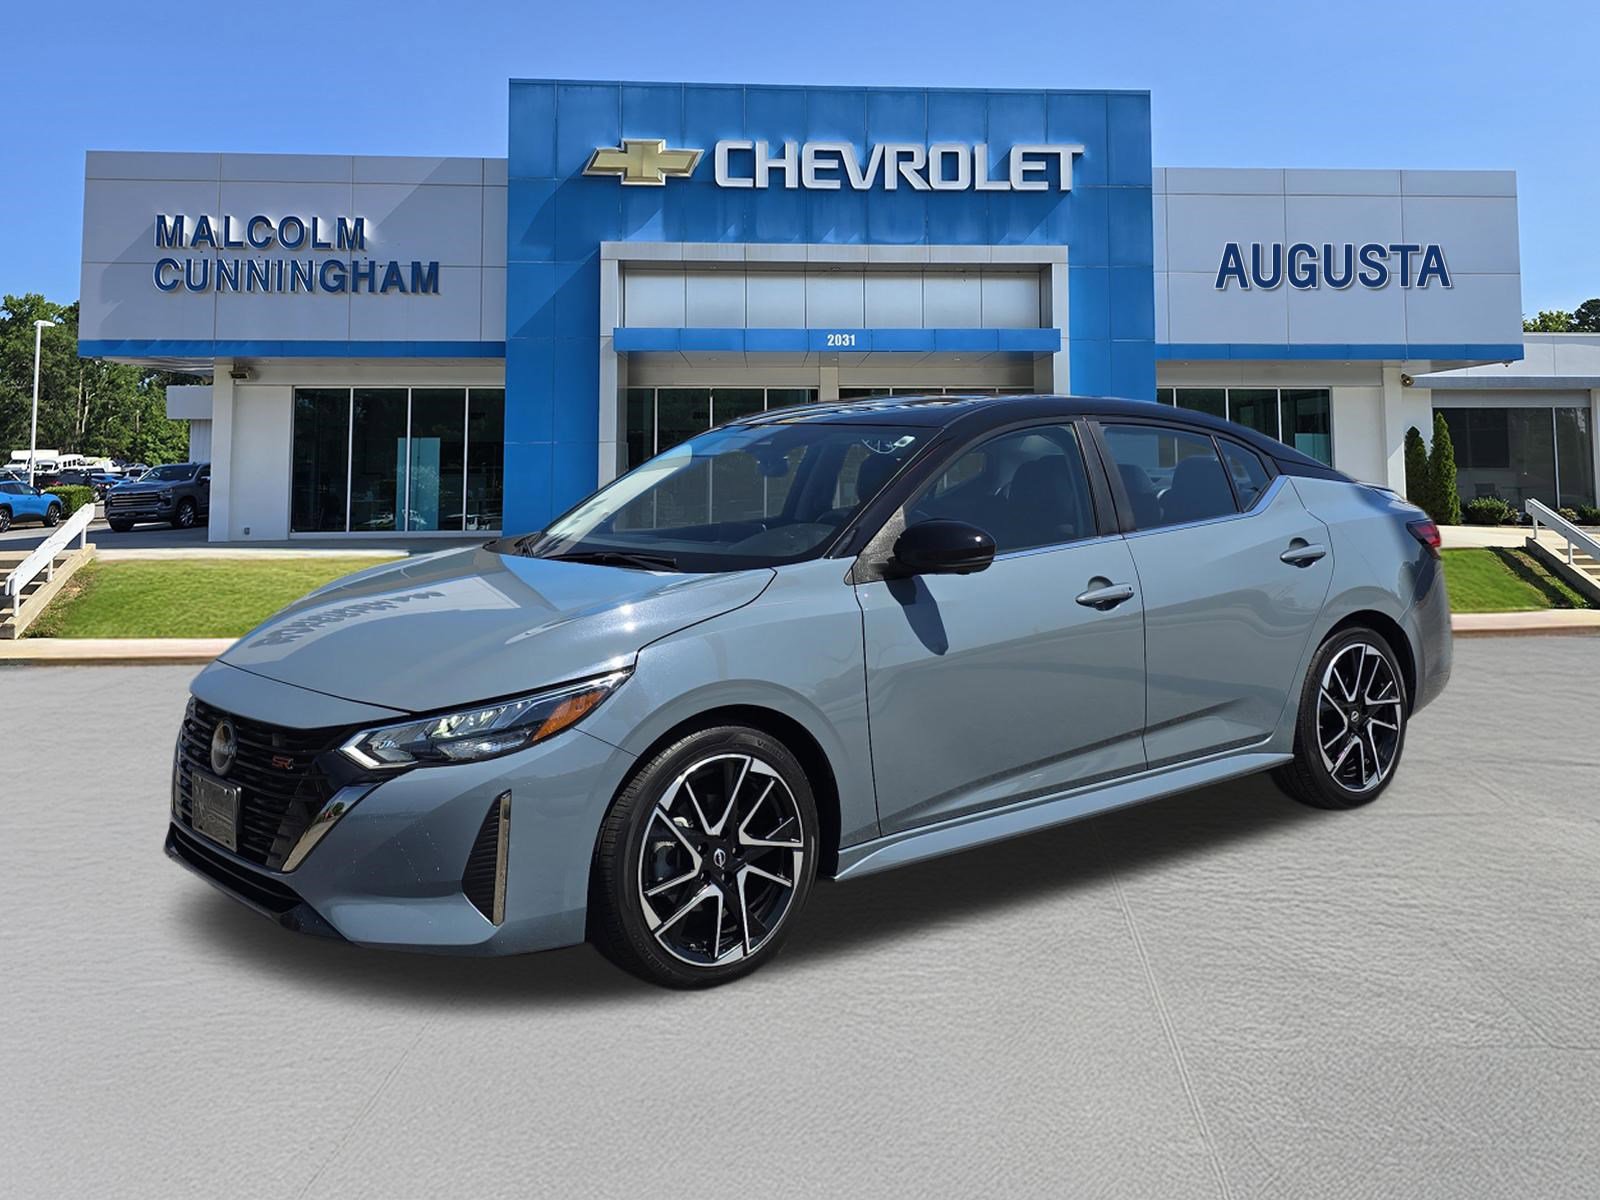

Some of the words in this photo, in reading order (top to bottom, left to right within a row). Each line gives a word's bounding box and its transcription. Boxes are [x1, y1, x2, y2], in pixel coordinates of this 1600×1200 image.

[714, 140, 1085, 191] CHEVROLET
[154, 214, 367, 250] MALCOLM
[153, 257, 441, 294] CUNNINGHAM
[1215, 242, 1452, 290] AUGUSTA
[827, 333, 856, 347] 2031
